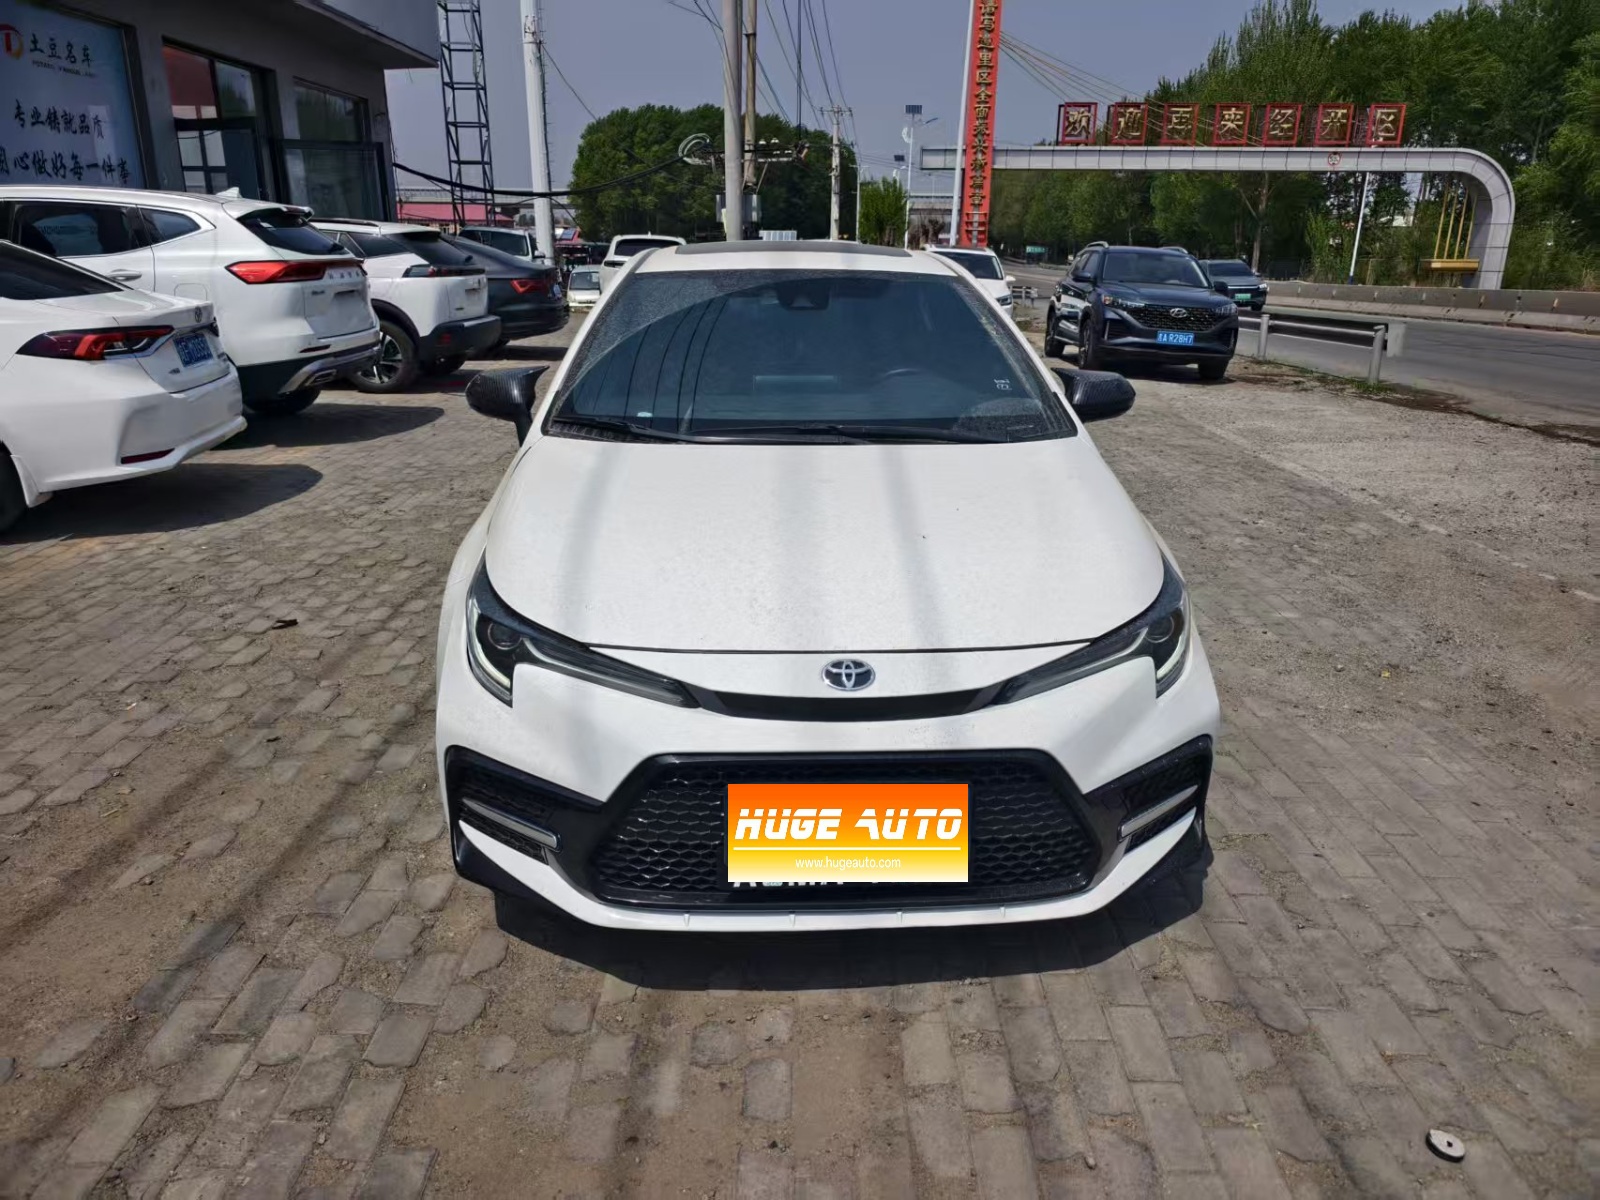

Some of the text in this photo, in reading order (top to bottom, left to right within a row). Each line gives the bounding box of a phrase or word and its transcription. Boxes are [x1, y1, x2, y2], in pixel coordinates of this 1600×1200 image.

[29, 33, 94, 68] 土豆名车
[14, 98, 106, 139] 专业铸就品质
